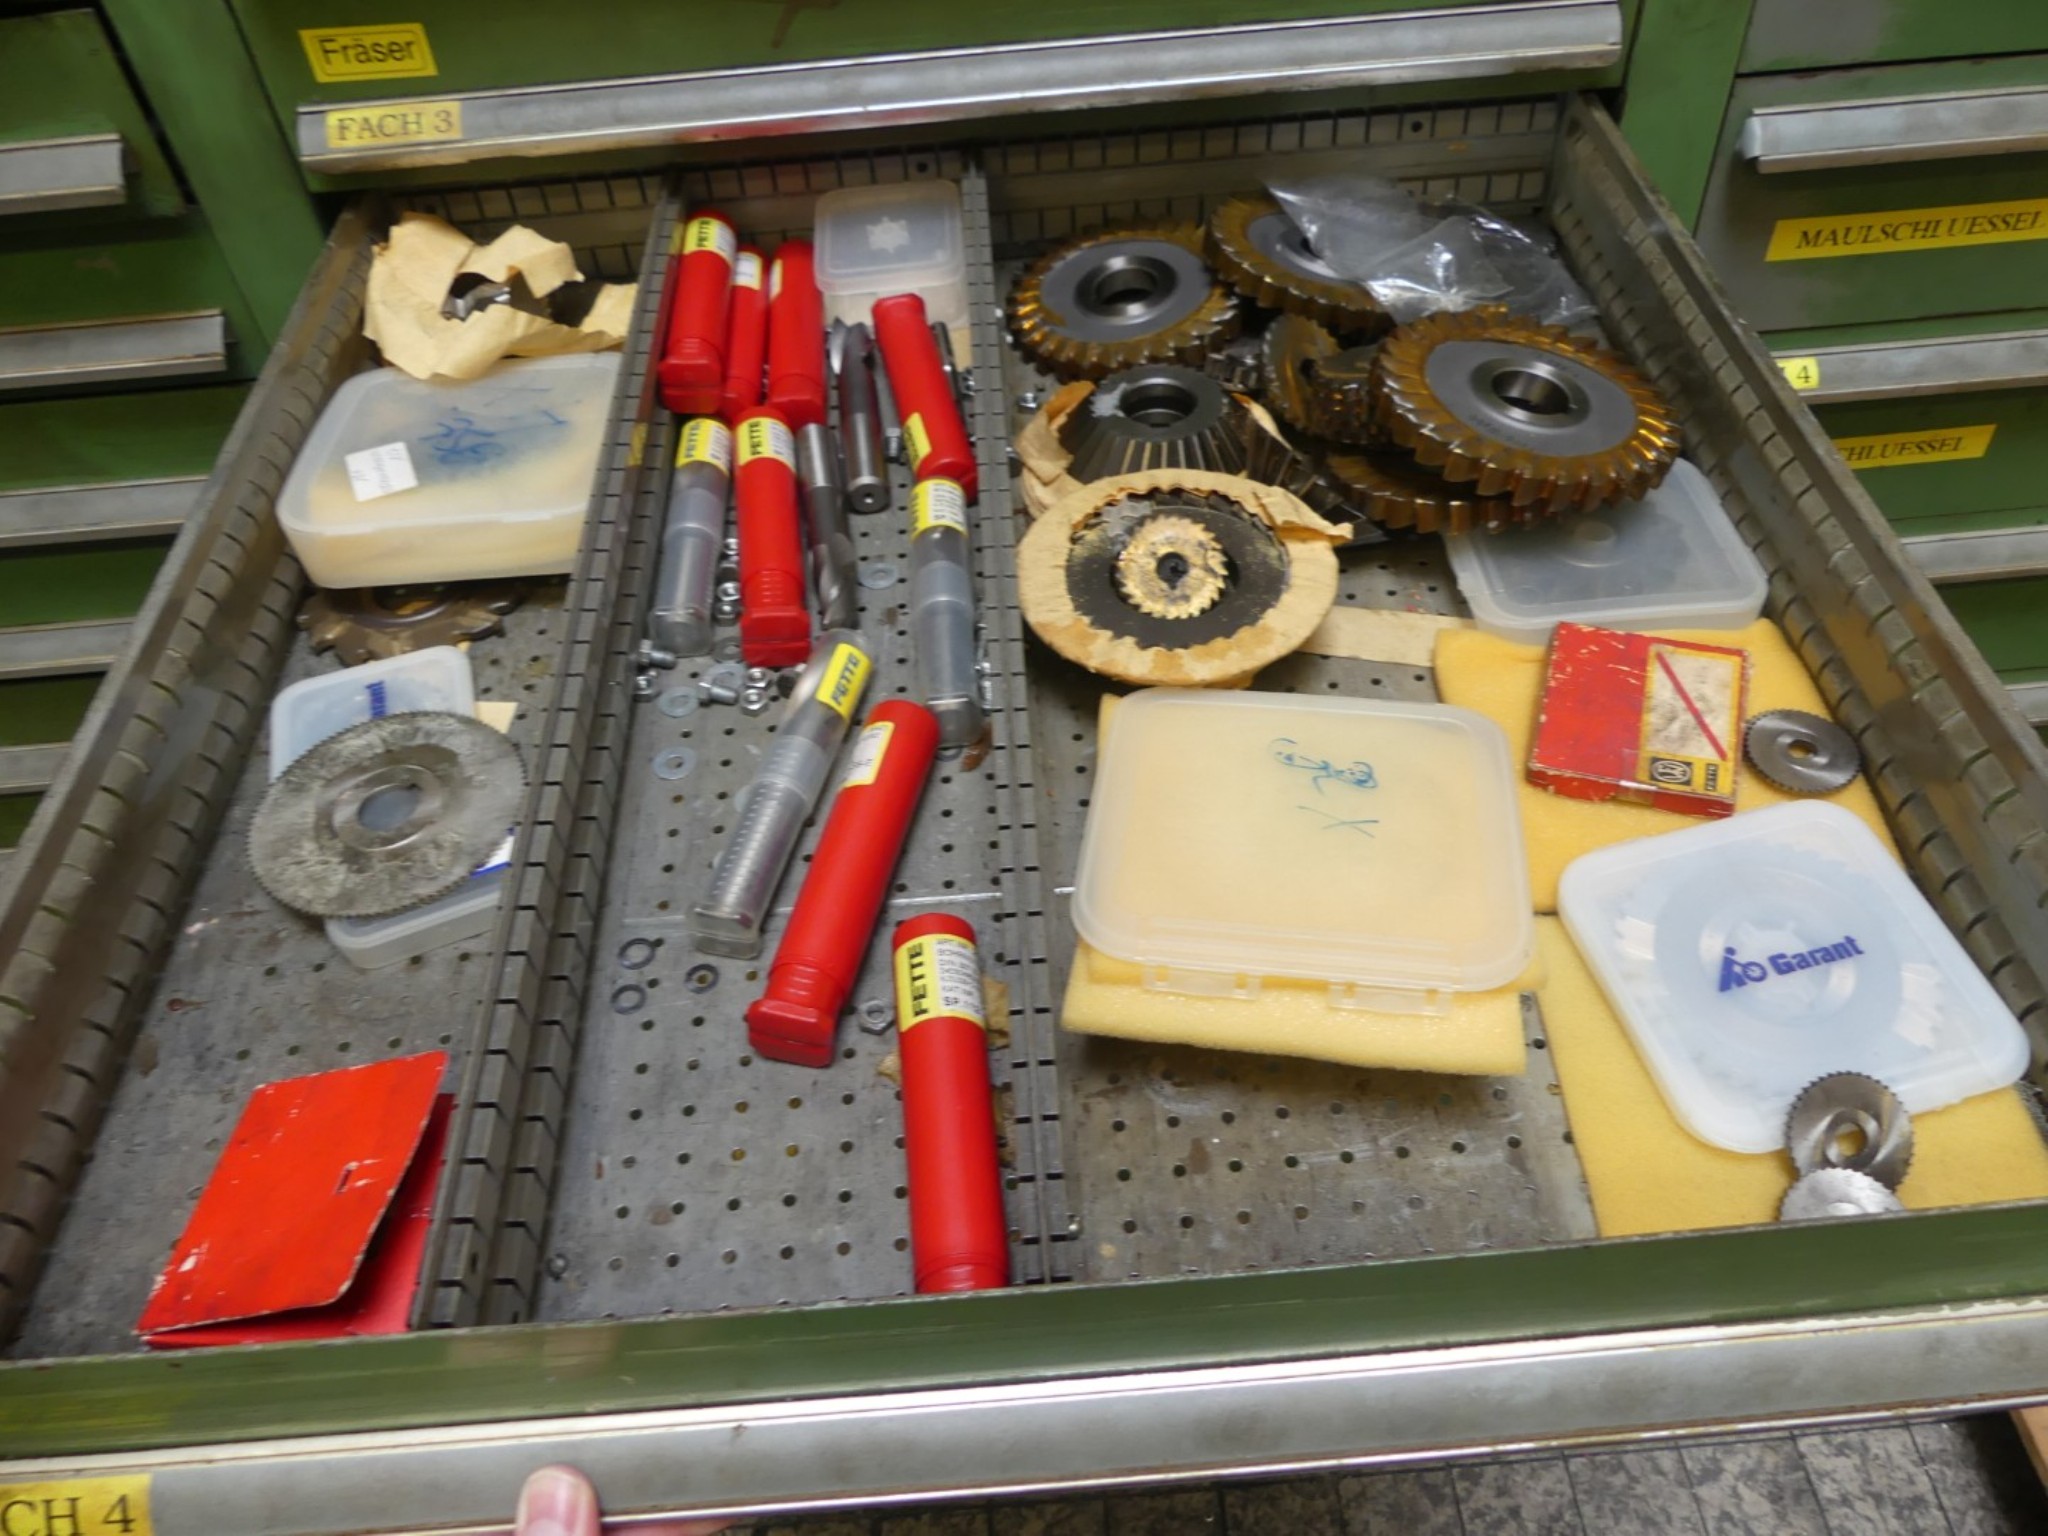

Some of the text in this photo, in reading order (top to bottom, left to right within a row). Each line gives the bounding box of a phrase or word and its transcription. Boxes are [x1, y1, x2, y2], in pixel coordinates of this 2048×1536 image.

[318, 37, 416, 66] Fräser
[335, 109, 454, 141] FACH 3
[1796, 210, 2046, 249] MAULSCHLUESSEL
[1795, 364, 1812, 384] 4
[748, 420, 762, 456] FETTE
[1767, 935, 1865, 976] Garant
[906, 942, 929, 1017] FETTE
[101, 1493, 137, 1534] 4
